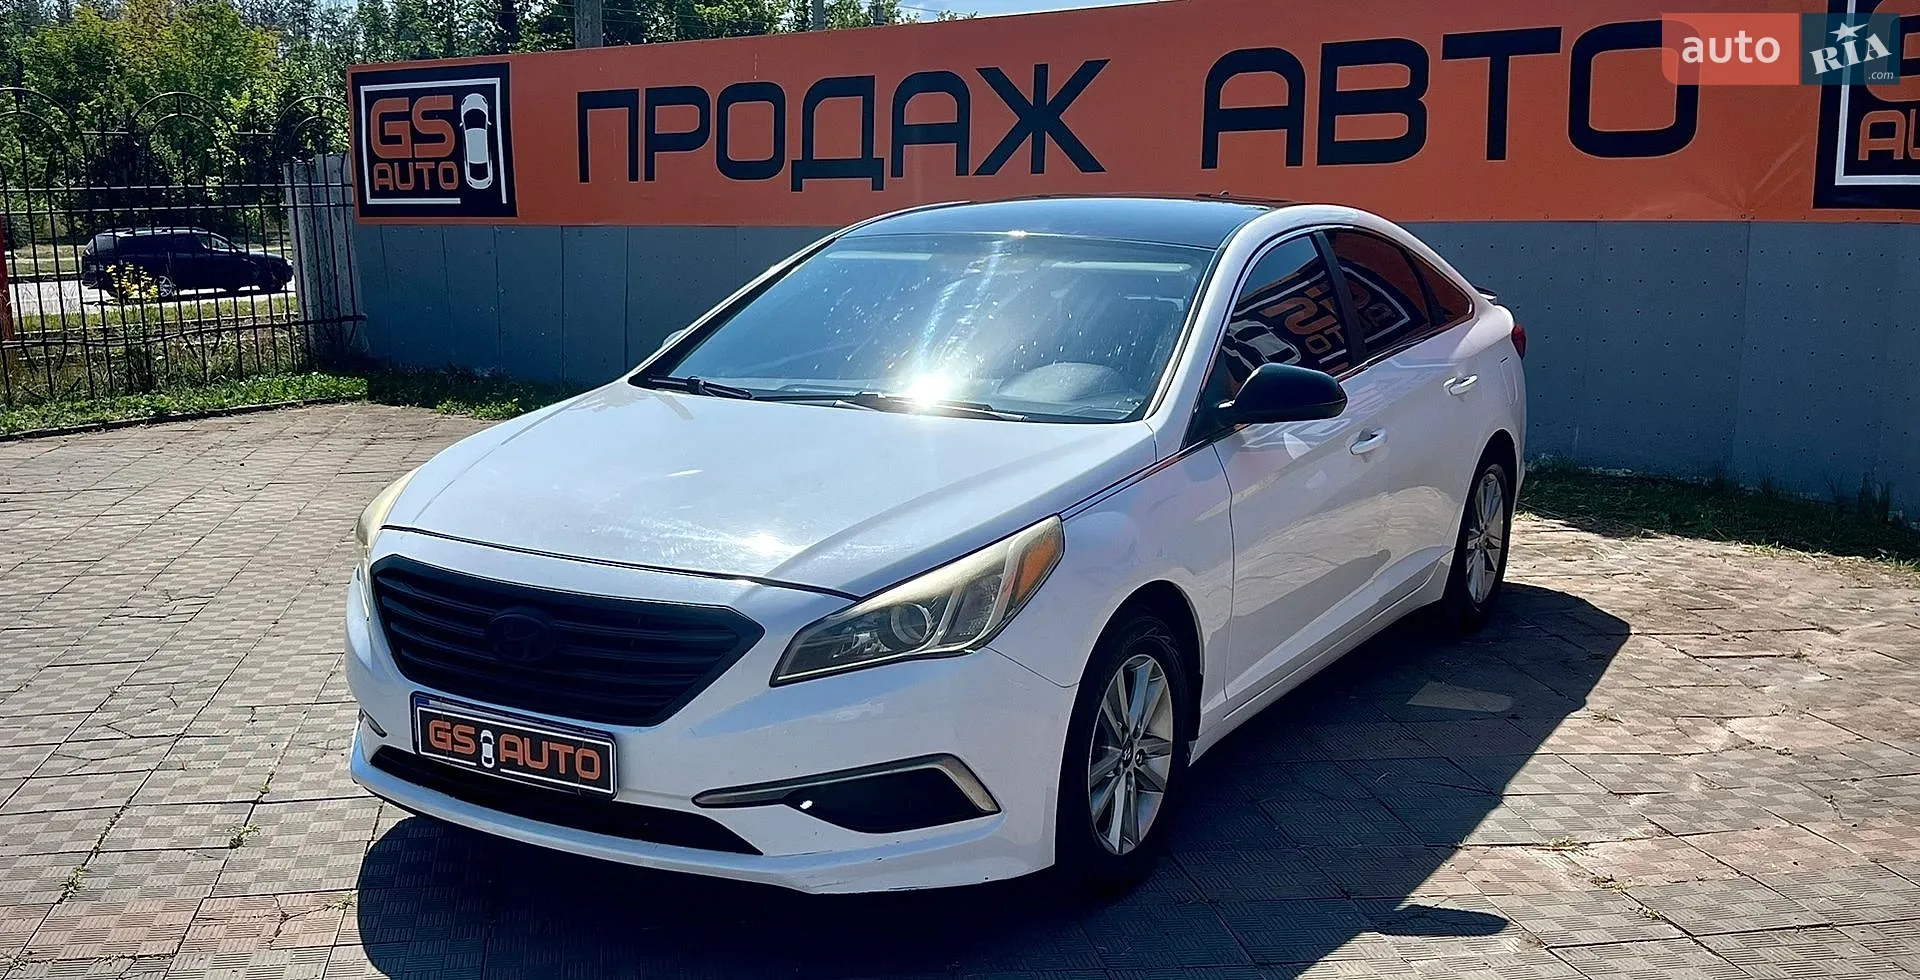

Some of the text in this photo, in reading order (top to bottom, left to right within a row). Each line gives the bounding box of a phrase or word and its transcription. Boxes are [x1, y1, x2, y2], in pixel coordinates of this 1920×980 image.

[371, 95, 456, 159] GS
[577, 19, 1701, 193] ПРОДАЖ АВТО
[1858, 109, 1920, 161] A
[373, 161, 459, 191] AUTO
[428, 719, 601, 780] GS AUTO
